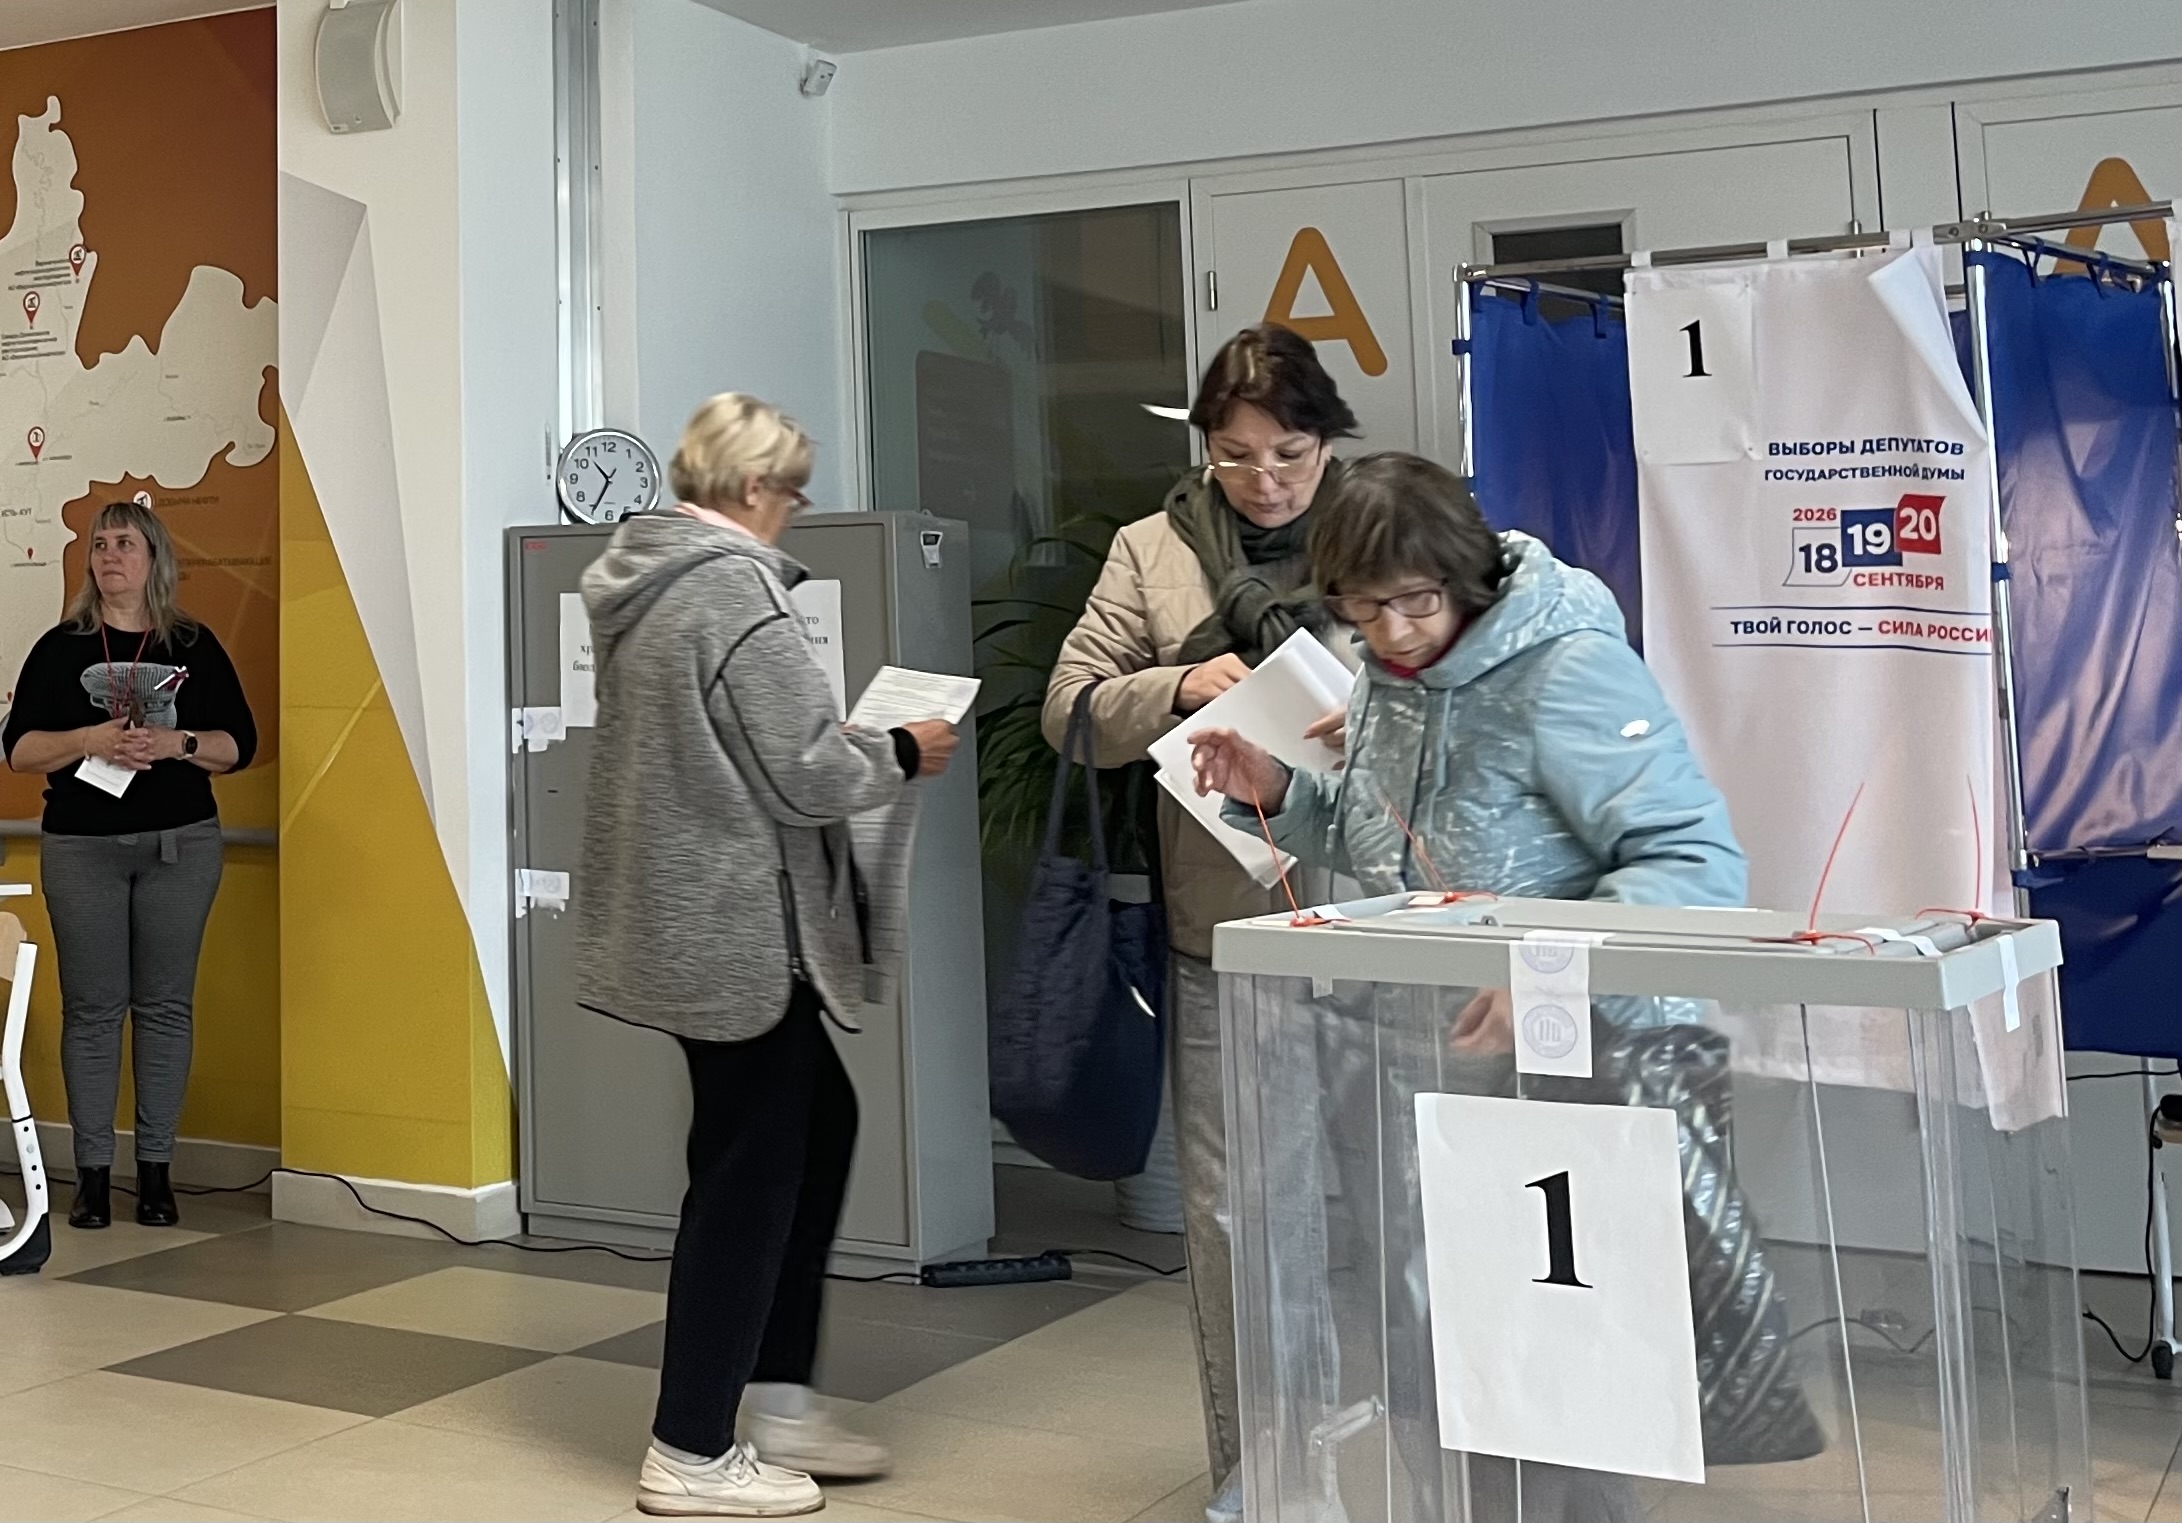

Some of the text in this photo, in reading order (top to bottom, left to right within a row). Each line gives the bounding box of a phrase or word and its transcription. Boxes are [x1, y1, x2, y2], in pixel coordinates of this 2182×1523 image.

[1679, 319, 1713, 378] 1
[585, 446, 598, 457] 11
[601, 441, 617, 453] 12
[1768, 437, 1965, 456] ВЫБОРЫ ДЕПУТАТОВ
[625, 448, 632, 459] 1
[574, 458, 589, 469] 10
[635, 461, 644, 473] 2
[1764, 463, 1965, 481] ГОСУДАРСТВЕННОЙ ДУМЫ
[569, 473, 579, 485] 9
[639, 476, 649, 489] 3
[576, 490, 586, 503] 8
[633, 494, 642, 505] 4
[604, 509, 614, 521] 6
[1792, 507, 1837, 522] 2026
[1798, 507, 1937, 574] 18 19 20
[1853, 572, 1945, 591] СЕНТЯБРЯ
[1730, 617, 1782, 635] ТВОЙ
[1787, 620, 1852, 635] ГОЛОС
[1877, 620, 1924, 638] СИЛА
[1525, 1170, 1594, 1289] 1
